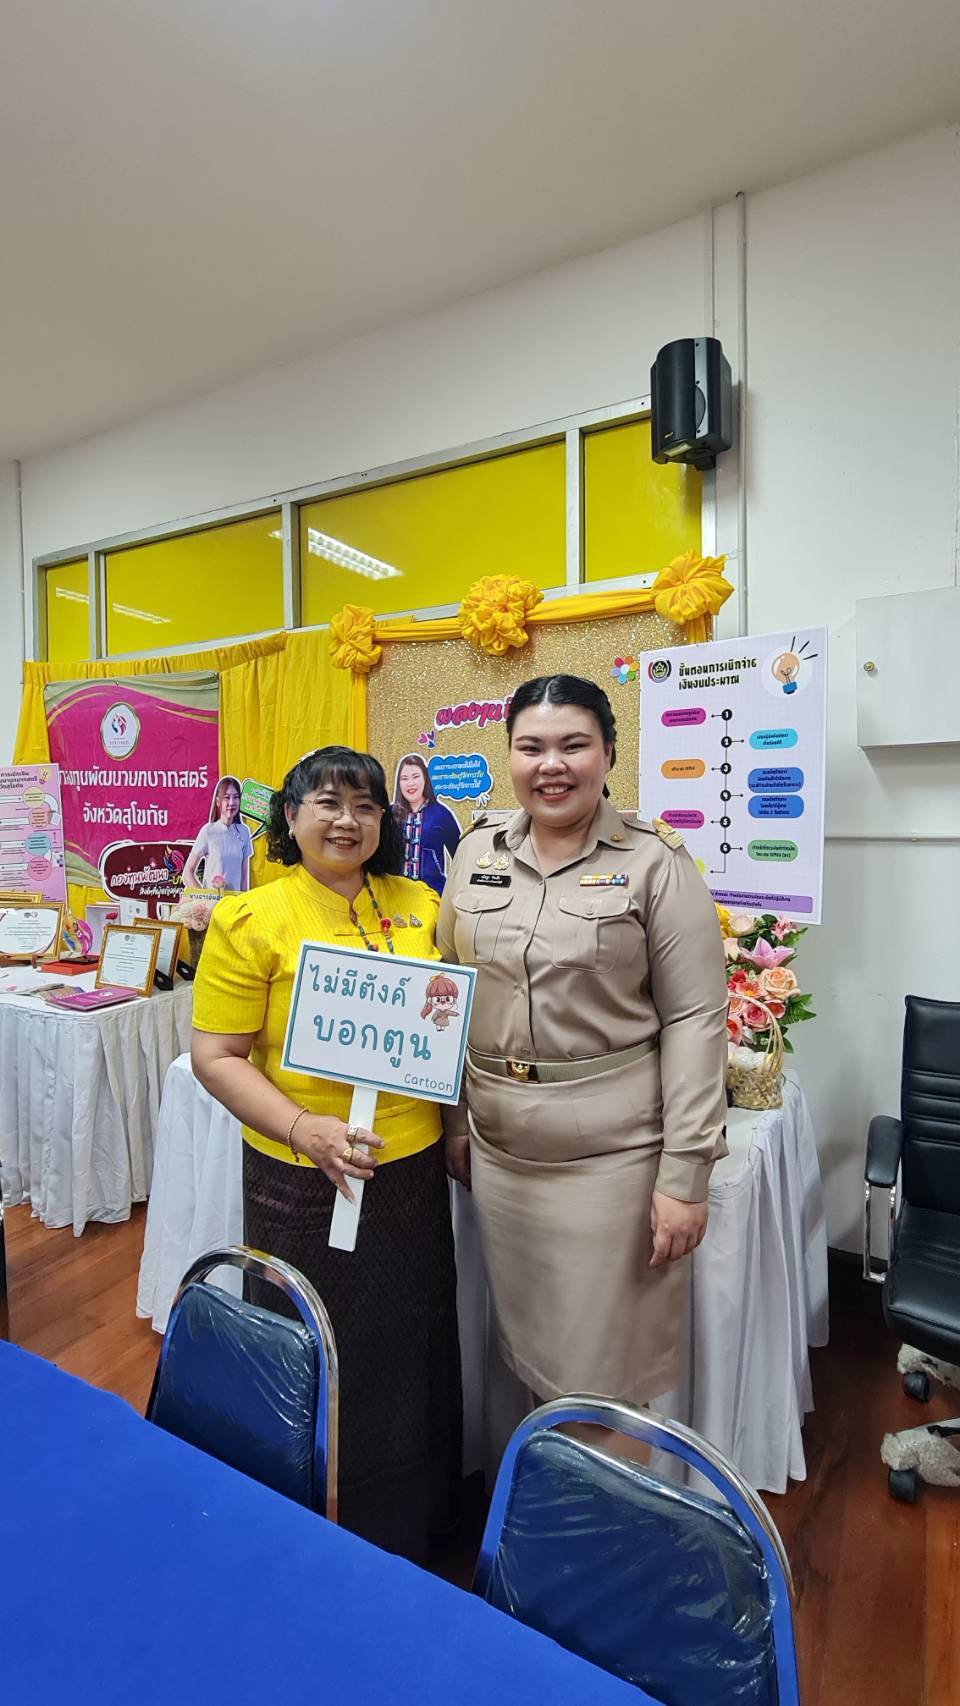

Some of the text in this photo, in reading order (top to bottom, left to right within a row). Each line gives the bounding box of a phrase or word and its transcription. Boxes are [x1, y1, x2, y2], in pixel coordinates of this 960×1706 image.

[679, 657, 757, 677] ขั้นตอนการเบิกจ่าย
[679, 675, 740, 690] เงินงบประมาณ
[83, 801, 168, 830] จังหวัดสุโขทัย
[111, 866, 169, 890] กองทุนพัฒนา
[309, 963, 411, 1008] ไม่มีตังค์
[313, 1014, 432, 1069] บอกตูน
[404, 1074, 453, 1092] Cartoon
